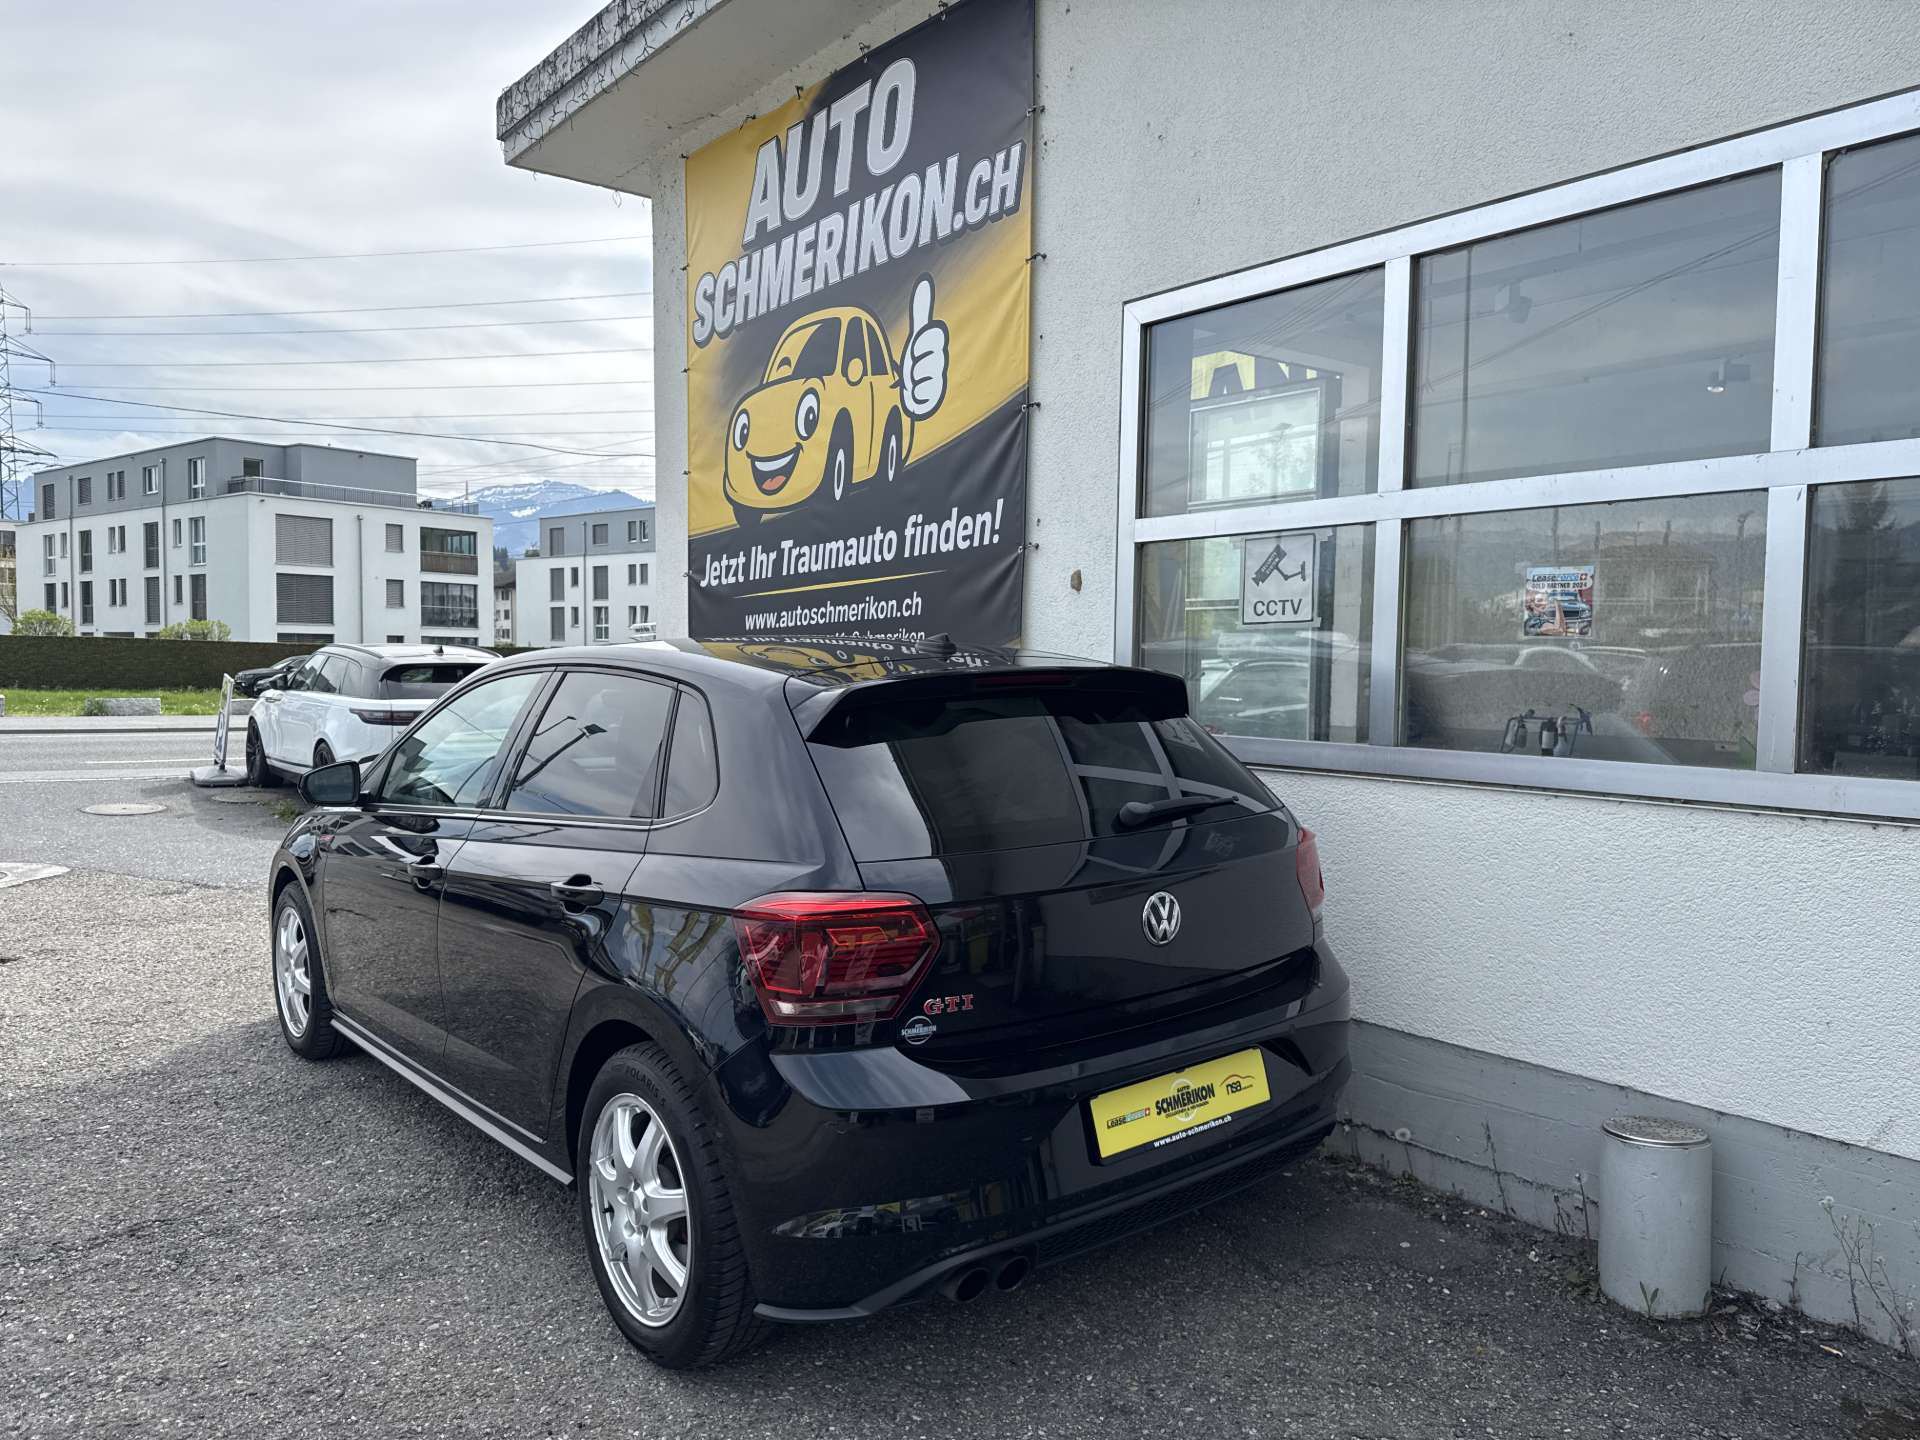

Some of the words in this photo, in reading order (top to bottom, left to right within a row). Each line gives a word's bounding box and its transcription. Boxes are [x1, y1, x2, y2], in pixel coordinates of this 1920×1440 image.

[743, 57, 917, 246] AUTO
[693, 141, 1024, 345] SCHMERIKON.CH
[700, 550, 746, 588] Jetzt
[749, 545, 777, 581] Ihr
[780, 526, 898, 576] Traumauto
[903, 498, 1004, 558] finden!
[745, 592, 922, 630] www.autoschmerikon.ch
[1254, 599, 1303, 617] CCTV
[923, 994, 975, 1015] GTI
[1155, 1082, 1216, 1116] SCHMERIKON
[1153, 1115, 1232, 1148] www.auto-schmerikon.ch
